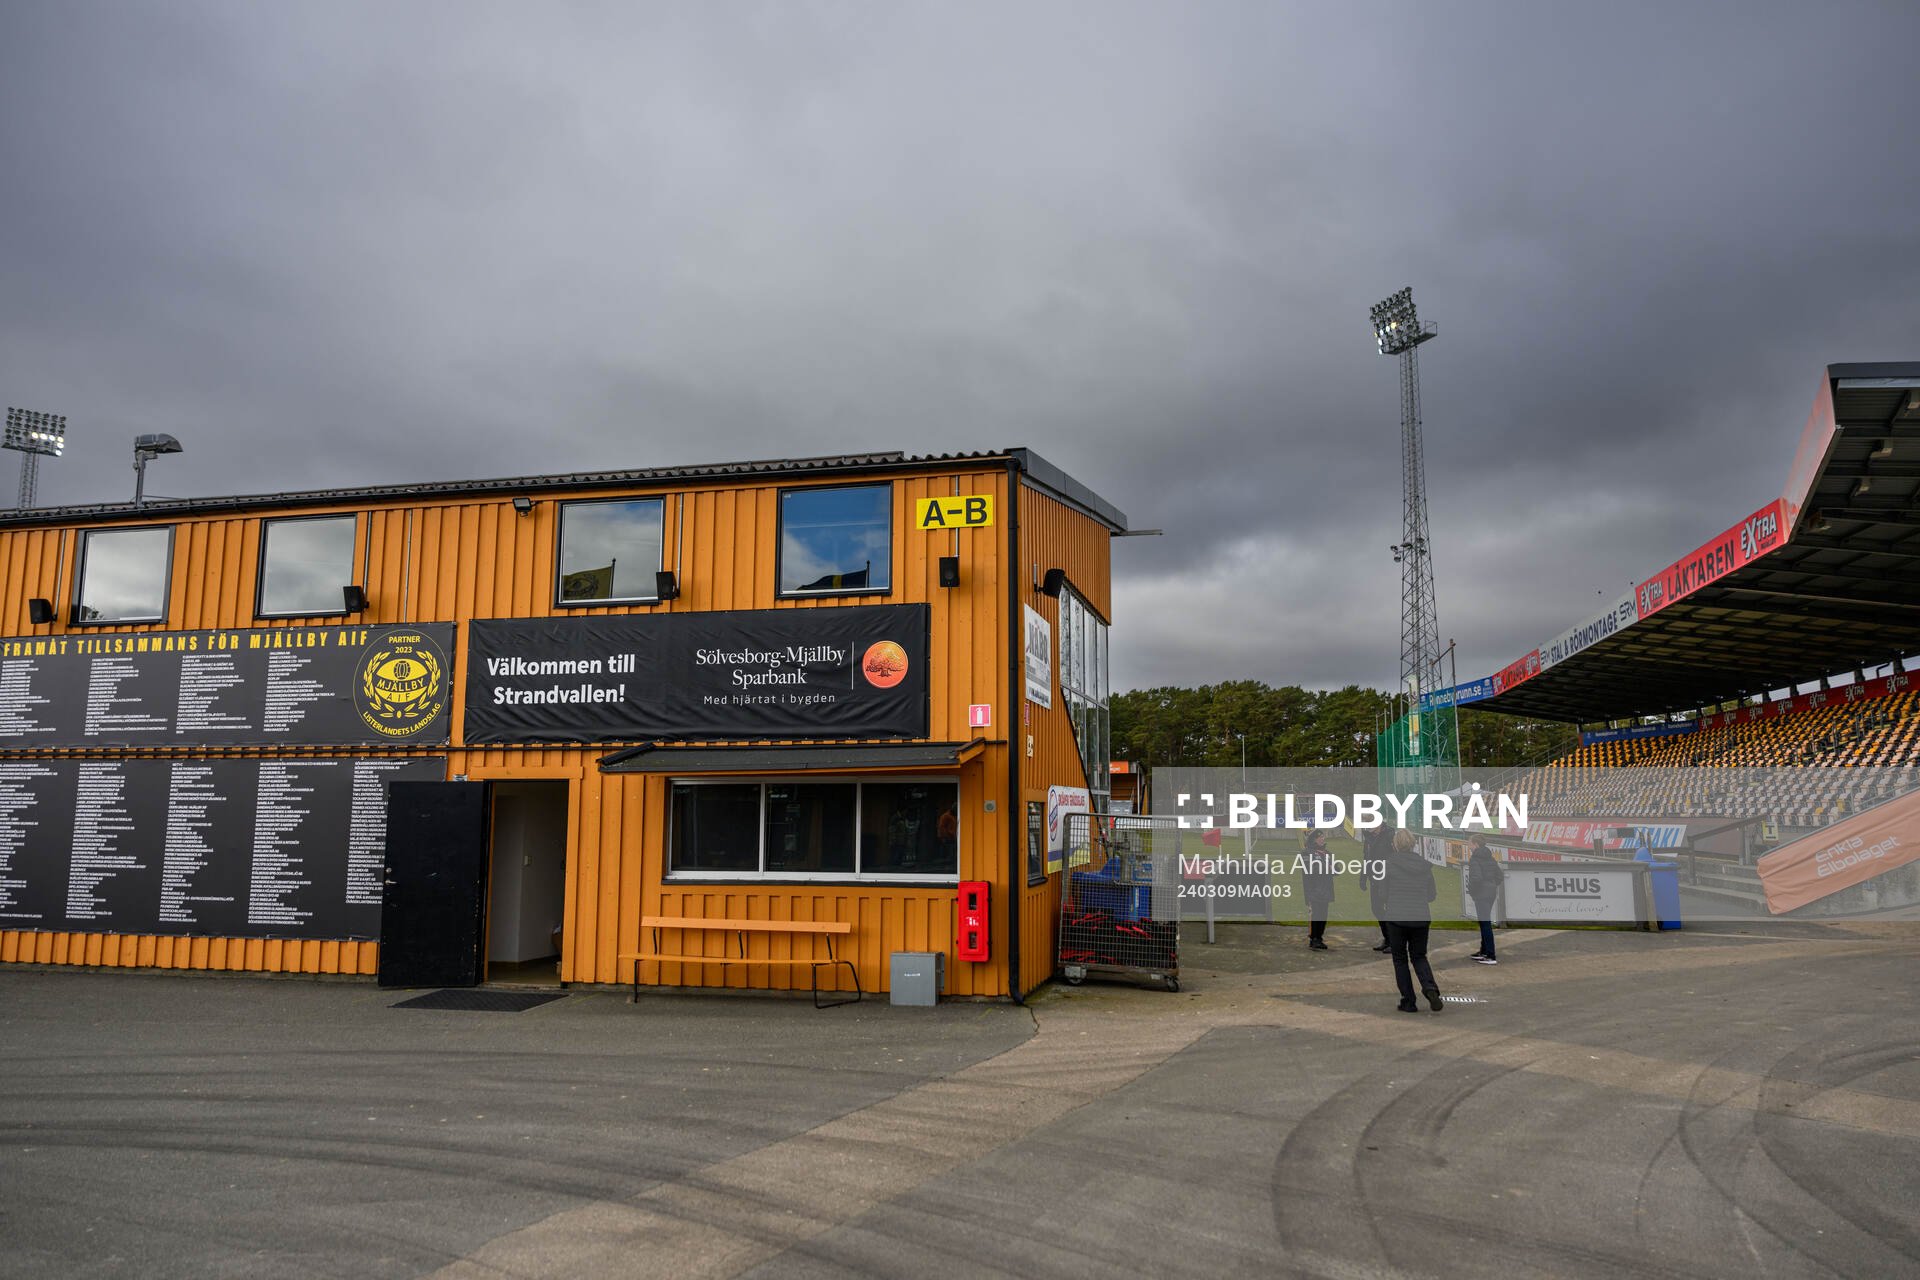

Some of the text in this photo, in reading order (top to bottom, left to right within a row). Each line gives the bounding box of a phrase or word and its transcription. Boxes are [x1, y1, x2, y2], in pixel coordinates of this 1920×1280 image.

[922, 497, 988, 527] A-B
[1741, 511, 1777, 559] EXTRA
[1667, 538, 1735, 602] LÄKTAREN
[1641, 581, 1664, 614] EXTRA
[3, 630, 369, 656] FRAMÅT TILLSAMMANS FÖR MJÄLLBY AIF
[388, 635, 421, 644] PARTNER
[1551, 640, 1563, 663] STÅL
[1570, 610, 1618, 653] RÖRMONTAGE
[395, 646, 413, 654] 2023
[695, 646, 846, 668] Sölvesborg-Mjällby
[487, 654, 636, 676] Välkommen till
[377, 678, 425, 692] MJÄLLBY
[732, 668, 807, 690] Sparbank
[387, 692, 412, 702] AIF
[493, 686, 626, 705] Strandvallen!
[703, 692, 836, 707] Med hjärtat i bygden
[1429, 684, 1482, 706] Rnnebyrunn.se
[362, 703, 442, 736] LISTERLANDETS LANDSLAG
[1817, 836, 1901, 877] Elbolaget
[1534, 877, 1601, 894] LB-HUS
[1529, 901, 1572, 915] Optimal
